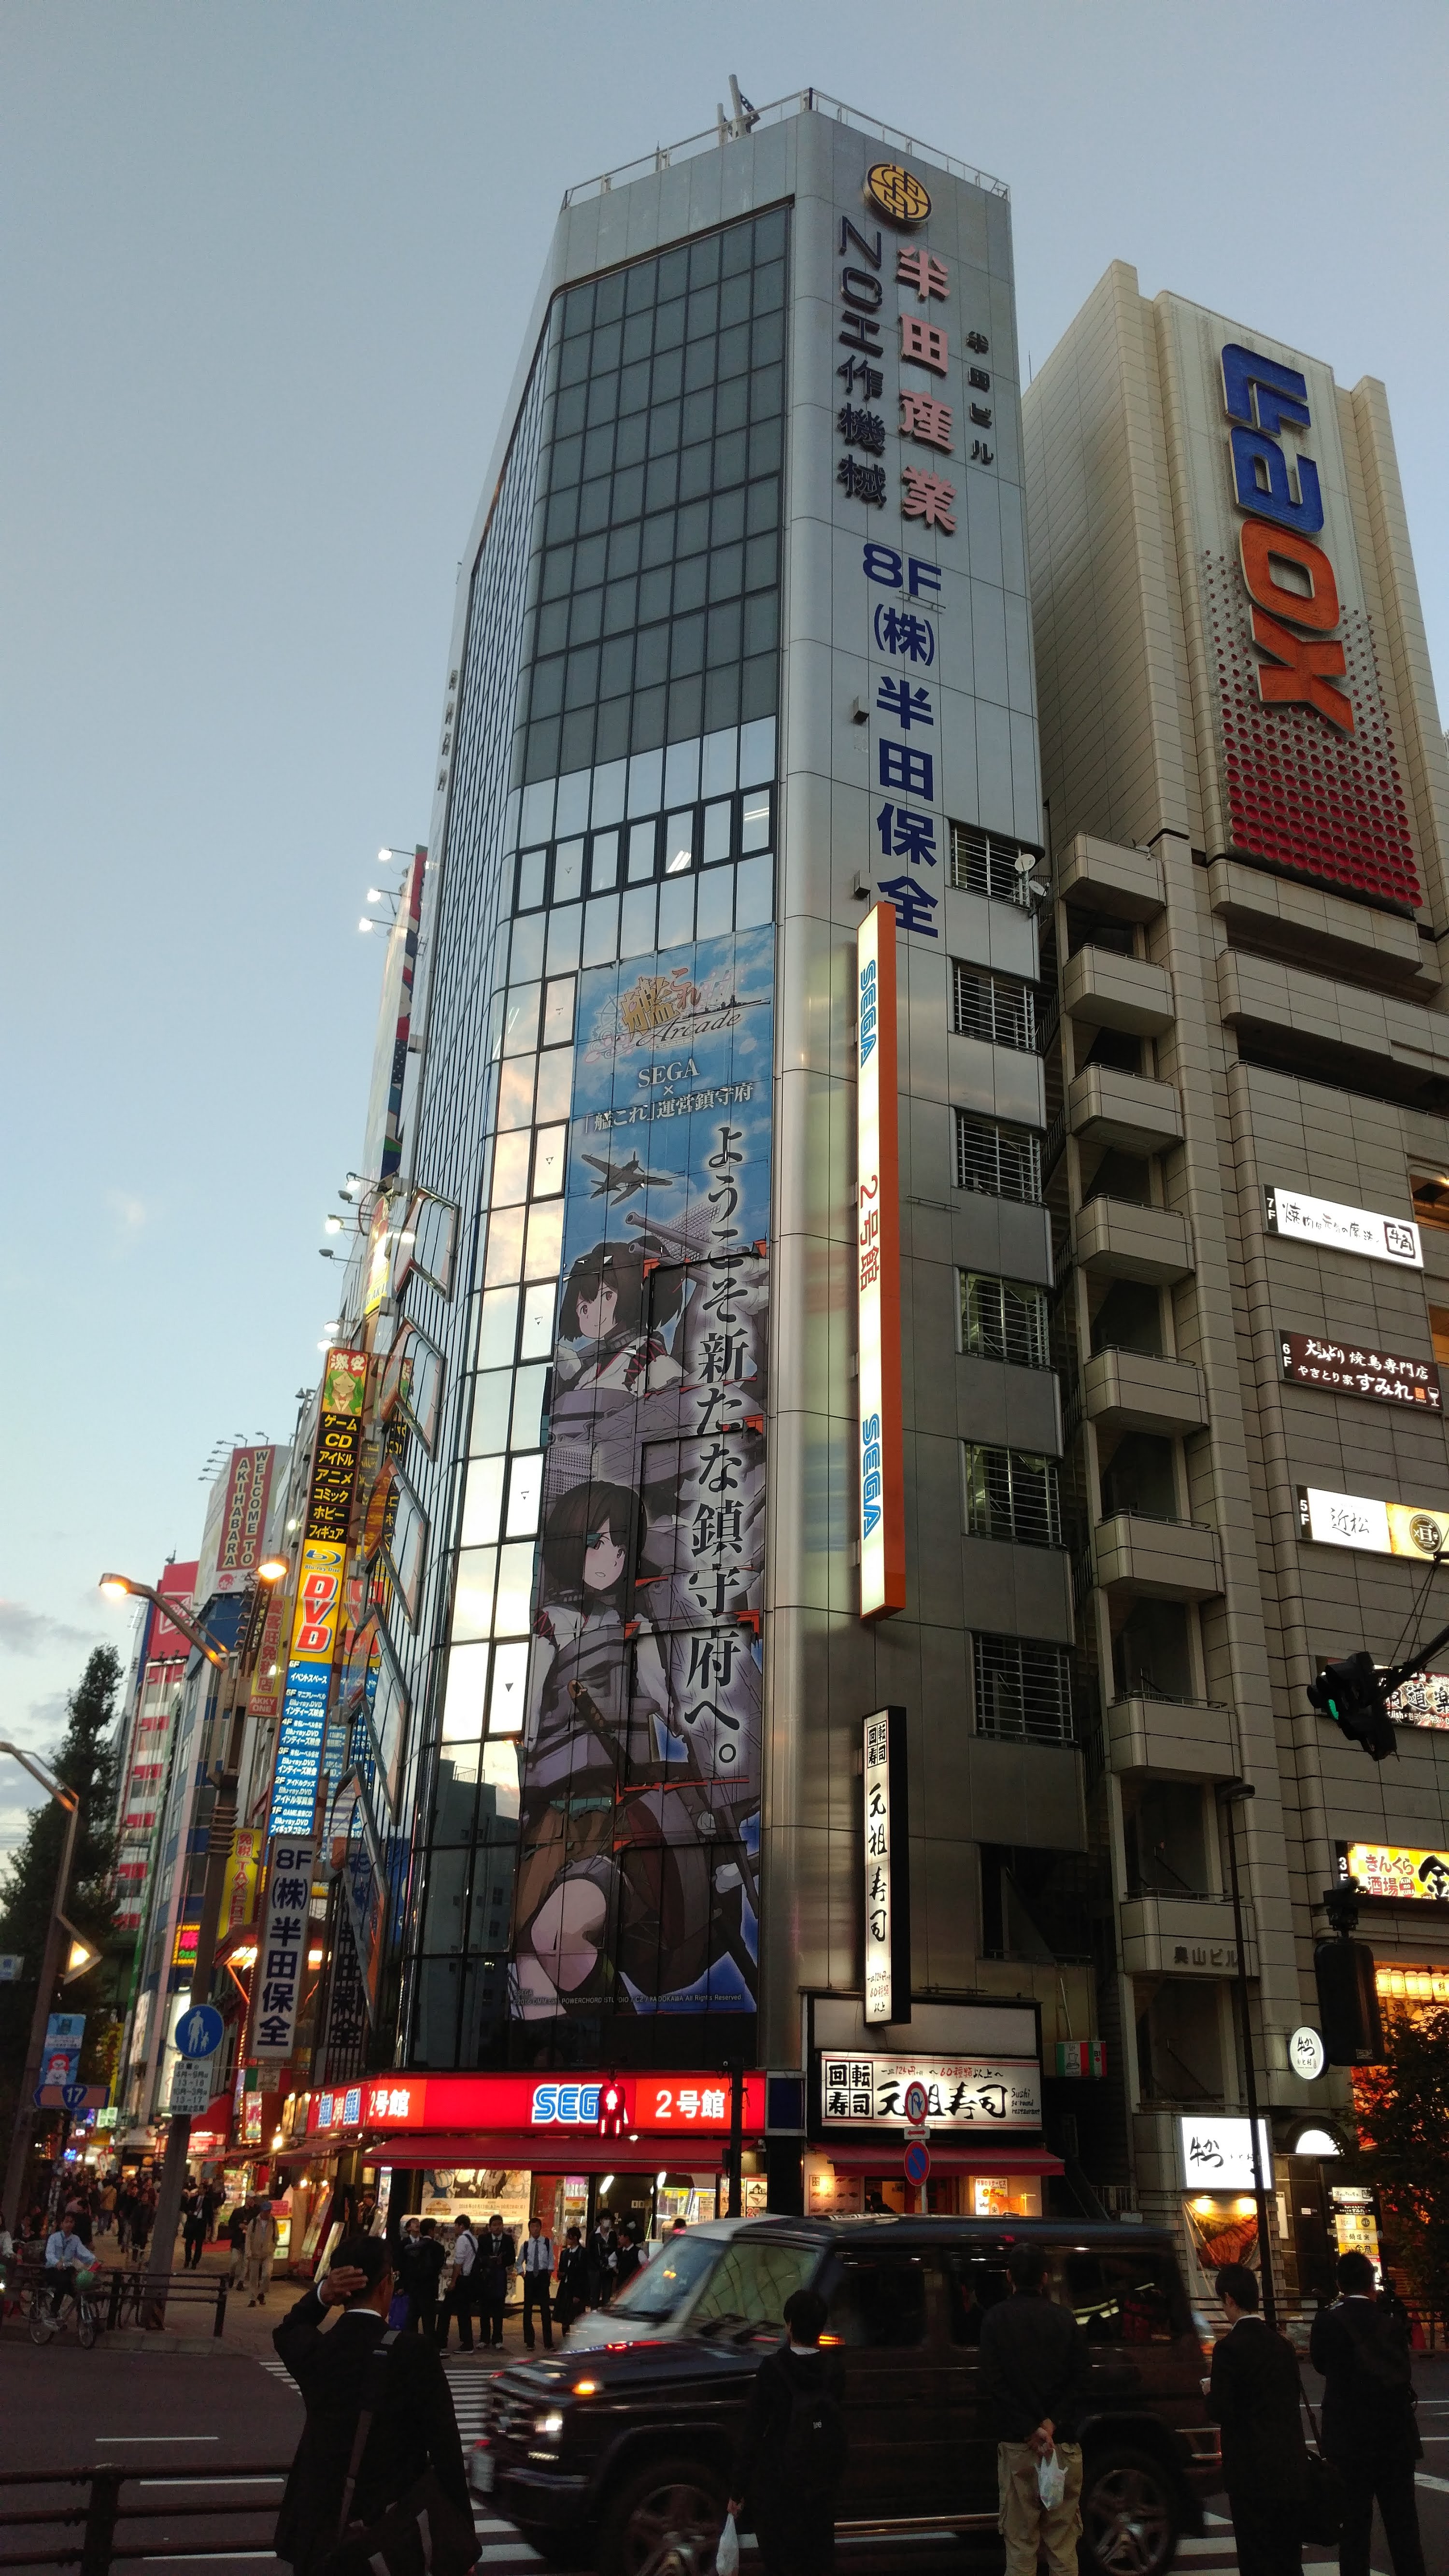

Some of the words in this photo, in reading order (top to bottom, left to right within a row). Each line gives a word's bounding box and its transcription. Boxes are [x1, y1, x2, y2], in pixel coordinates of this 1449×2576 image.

[895, 245, 957, 535] 半田産業
[966, 330, 994, 465] 半田ビル
[863, 543, 941, 597] 8F
[860, 959, 877, 1068] SEGA
[636, 1009, 742, 1047] Arcade
[638, 1058, 700, 1088] SEGA
[1266, 1198, 1276, 1220] 7F
[860, 1174, 880, 1292] 2号館
[1389, 1228, 1413, 1252] 牛角
[330, 1352, 365, 1371] 激安
[1282, 1343, 1292, 1367] 6F
[1298, 1365, 1354, 1386] やきとり家
[1356, 1373, 1415, 1400] すみれ
[324, 1414, 357, 1432] ゲーム
[325, 1433, 353, 1450] CD
[318, 1450, 354, 1467] アイドル
[315, 1468, 354, 1485] アニメ
[863, 1413, 881, 1541] SEGA
[246, 1450, 270, 1534] WELCOME
[313, 1488, 349, 1503] コミック
[222, 1457, 249, 1568] AKIHABARA
[313, 1505, 345, 1521] ホビー
[1299, 1499, 1310, 1526] 5F
[309, 1524, 344, 1540] フィギュア
[241, 1541, 256, 1566] TO
[295, 1573, 340, 1652] DVD
[290, 1672, 327, 1684] イベントスペース
[251, 1696, 274, 1705] AKKY
[252, 1705, 272, 1713] ONE
[285, 1707, 325, 1718] インディーズ映像
[281, 1735, 321, 1747] インディーズ映像
[867, 1724, 887, 1744] 回転
[278, 1747, 289, 1755] 3F
[867, 1745, 887, 1767] 寿司
[274, 1776, 286, 1784] 2F
[286, 1779, 316, 1787] アイドルグッズ
[278, 1765, 318, 1777] インディーズ映像
[271, 1806, 283, 1814] 1F
[274, 1795, 314, 1806] アイドル写真集
[275, 1848, 313, 1870] 8F
[867, 1782, 888, 1943] 元祖寿司
[1365, 1854, 1414, 1876] きんくら
[1367, 1876, 1399, 1896] 酒場
[257, 1877, 309, 2047] (株)半田保全
[874, 2001, 885, 2013] 以上
[828, 2064, 870, 2087] 回転
[67, 2087, 83, 2103] 17
[369, 2089, 411, 2118] 2号館
[828, 2092, 870, 2115] 寿司
[1011, 2088, 1031, 2098] Sushi
[655, 2089, 725, 2120] 2号館
